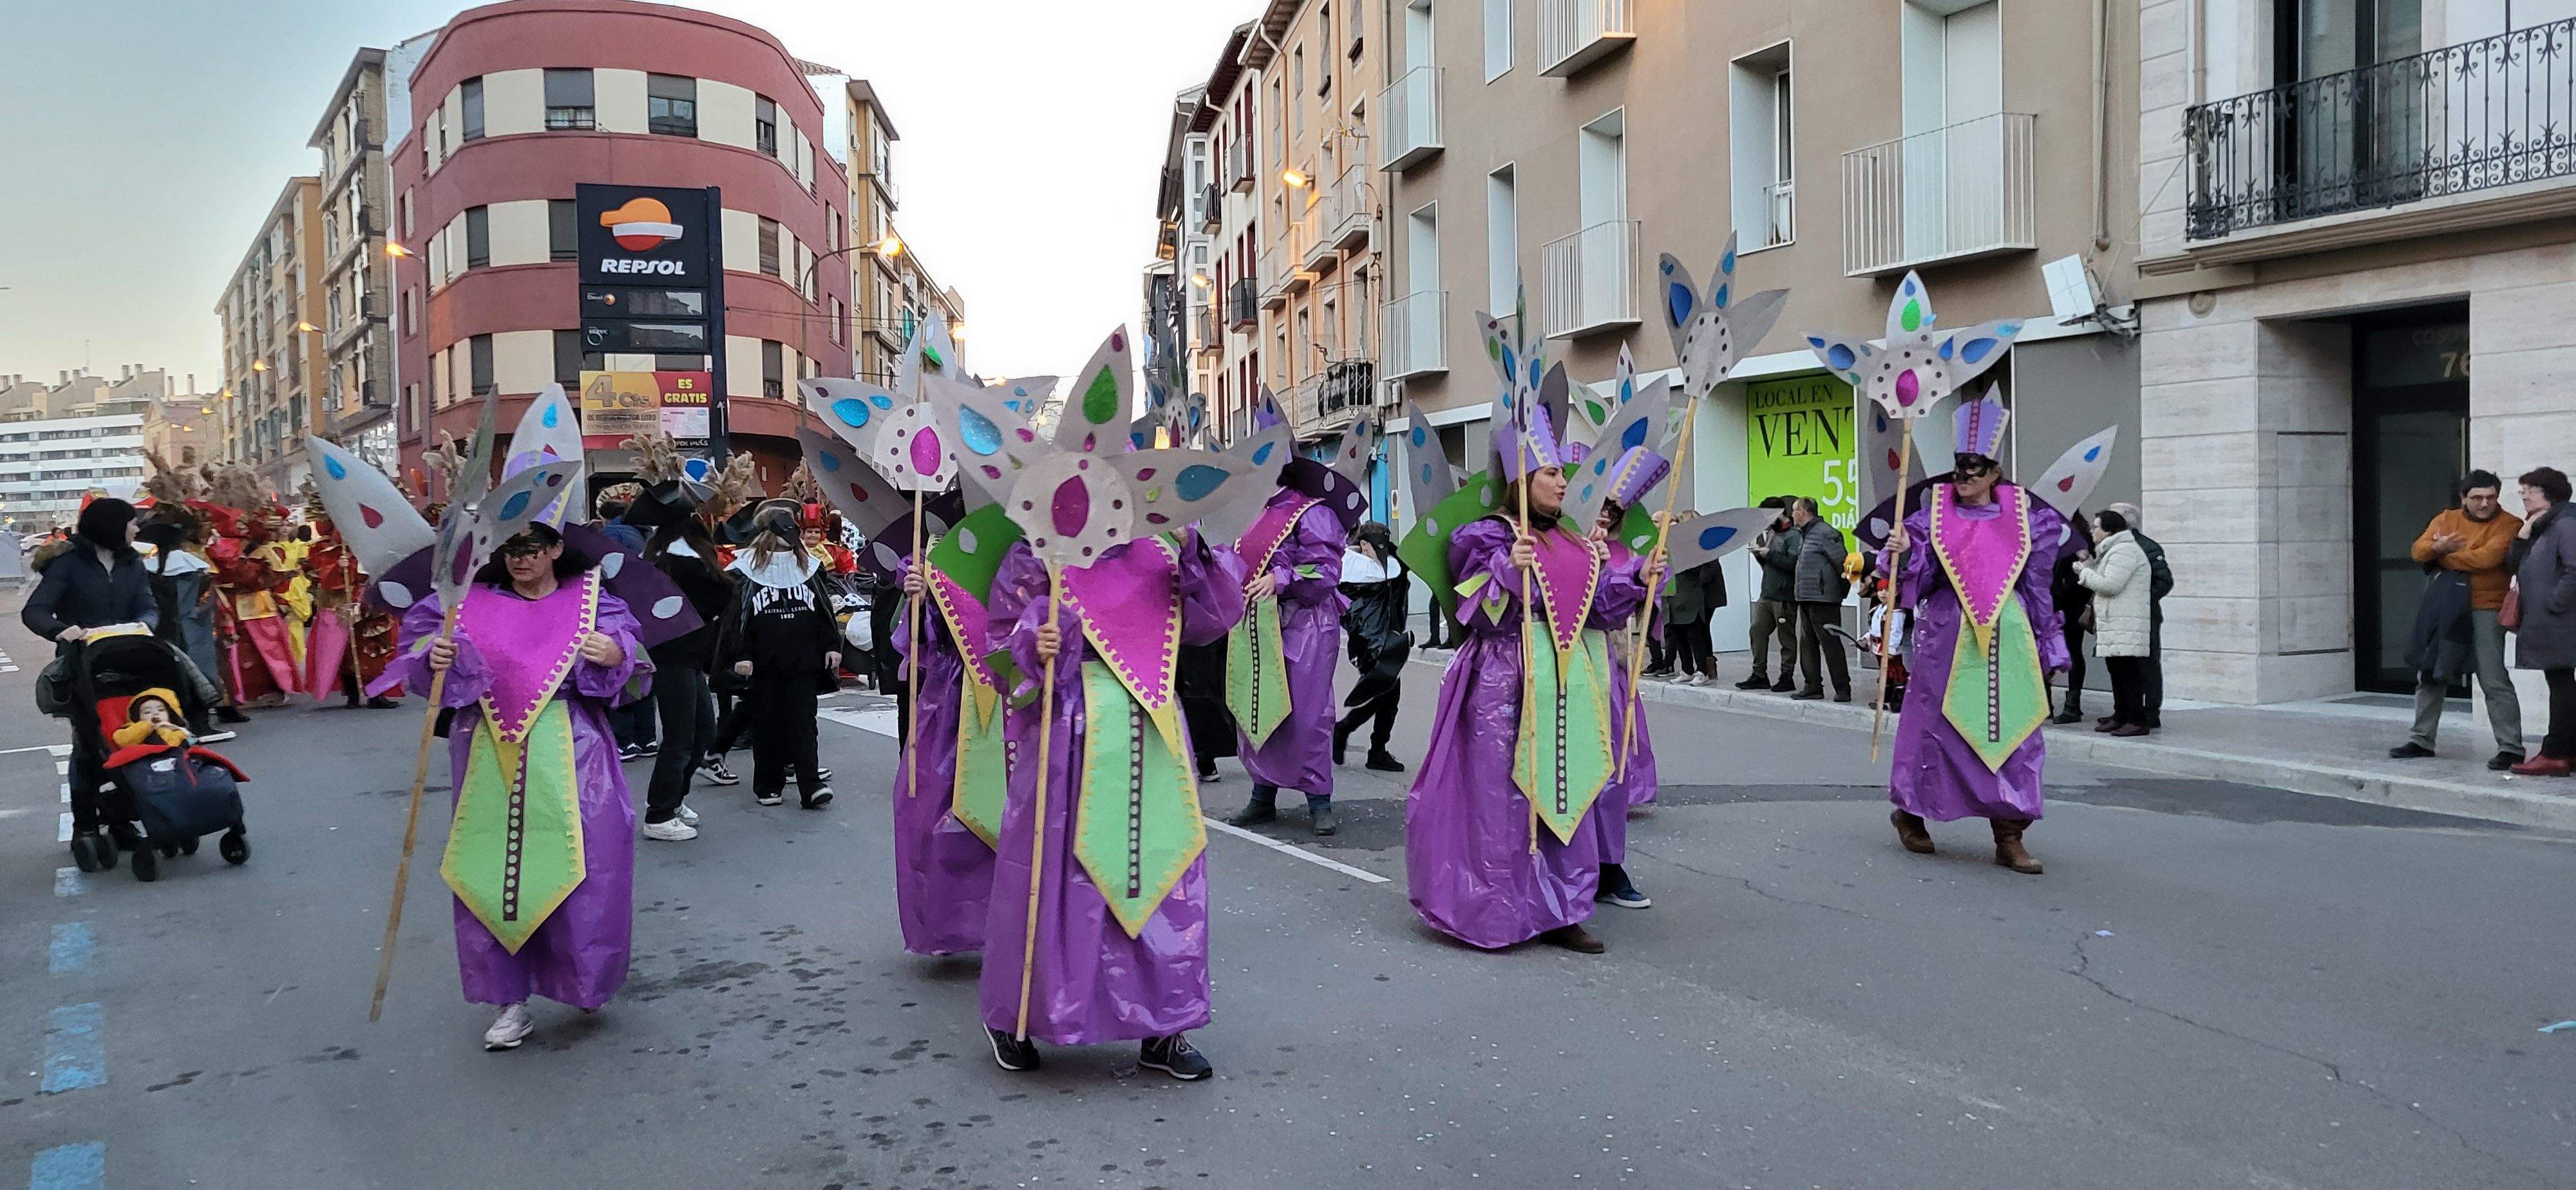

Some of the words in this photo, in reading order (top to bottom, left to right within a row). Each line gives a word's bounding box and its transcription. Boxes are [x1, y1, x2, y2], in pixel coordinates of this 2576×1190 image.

[601, 259, 685, 275] REPSOL
[585, 375, 616, 407] 4
[677, 379, 692, 389] ES
[664, 393, 707, 404] GRATIS
[1756, 386, 1806, 408] LOCAL
[1812, 384, 1833, 404] EN
[752, 586, 779, 616] NEW
